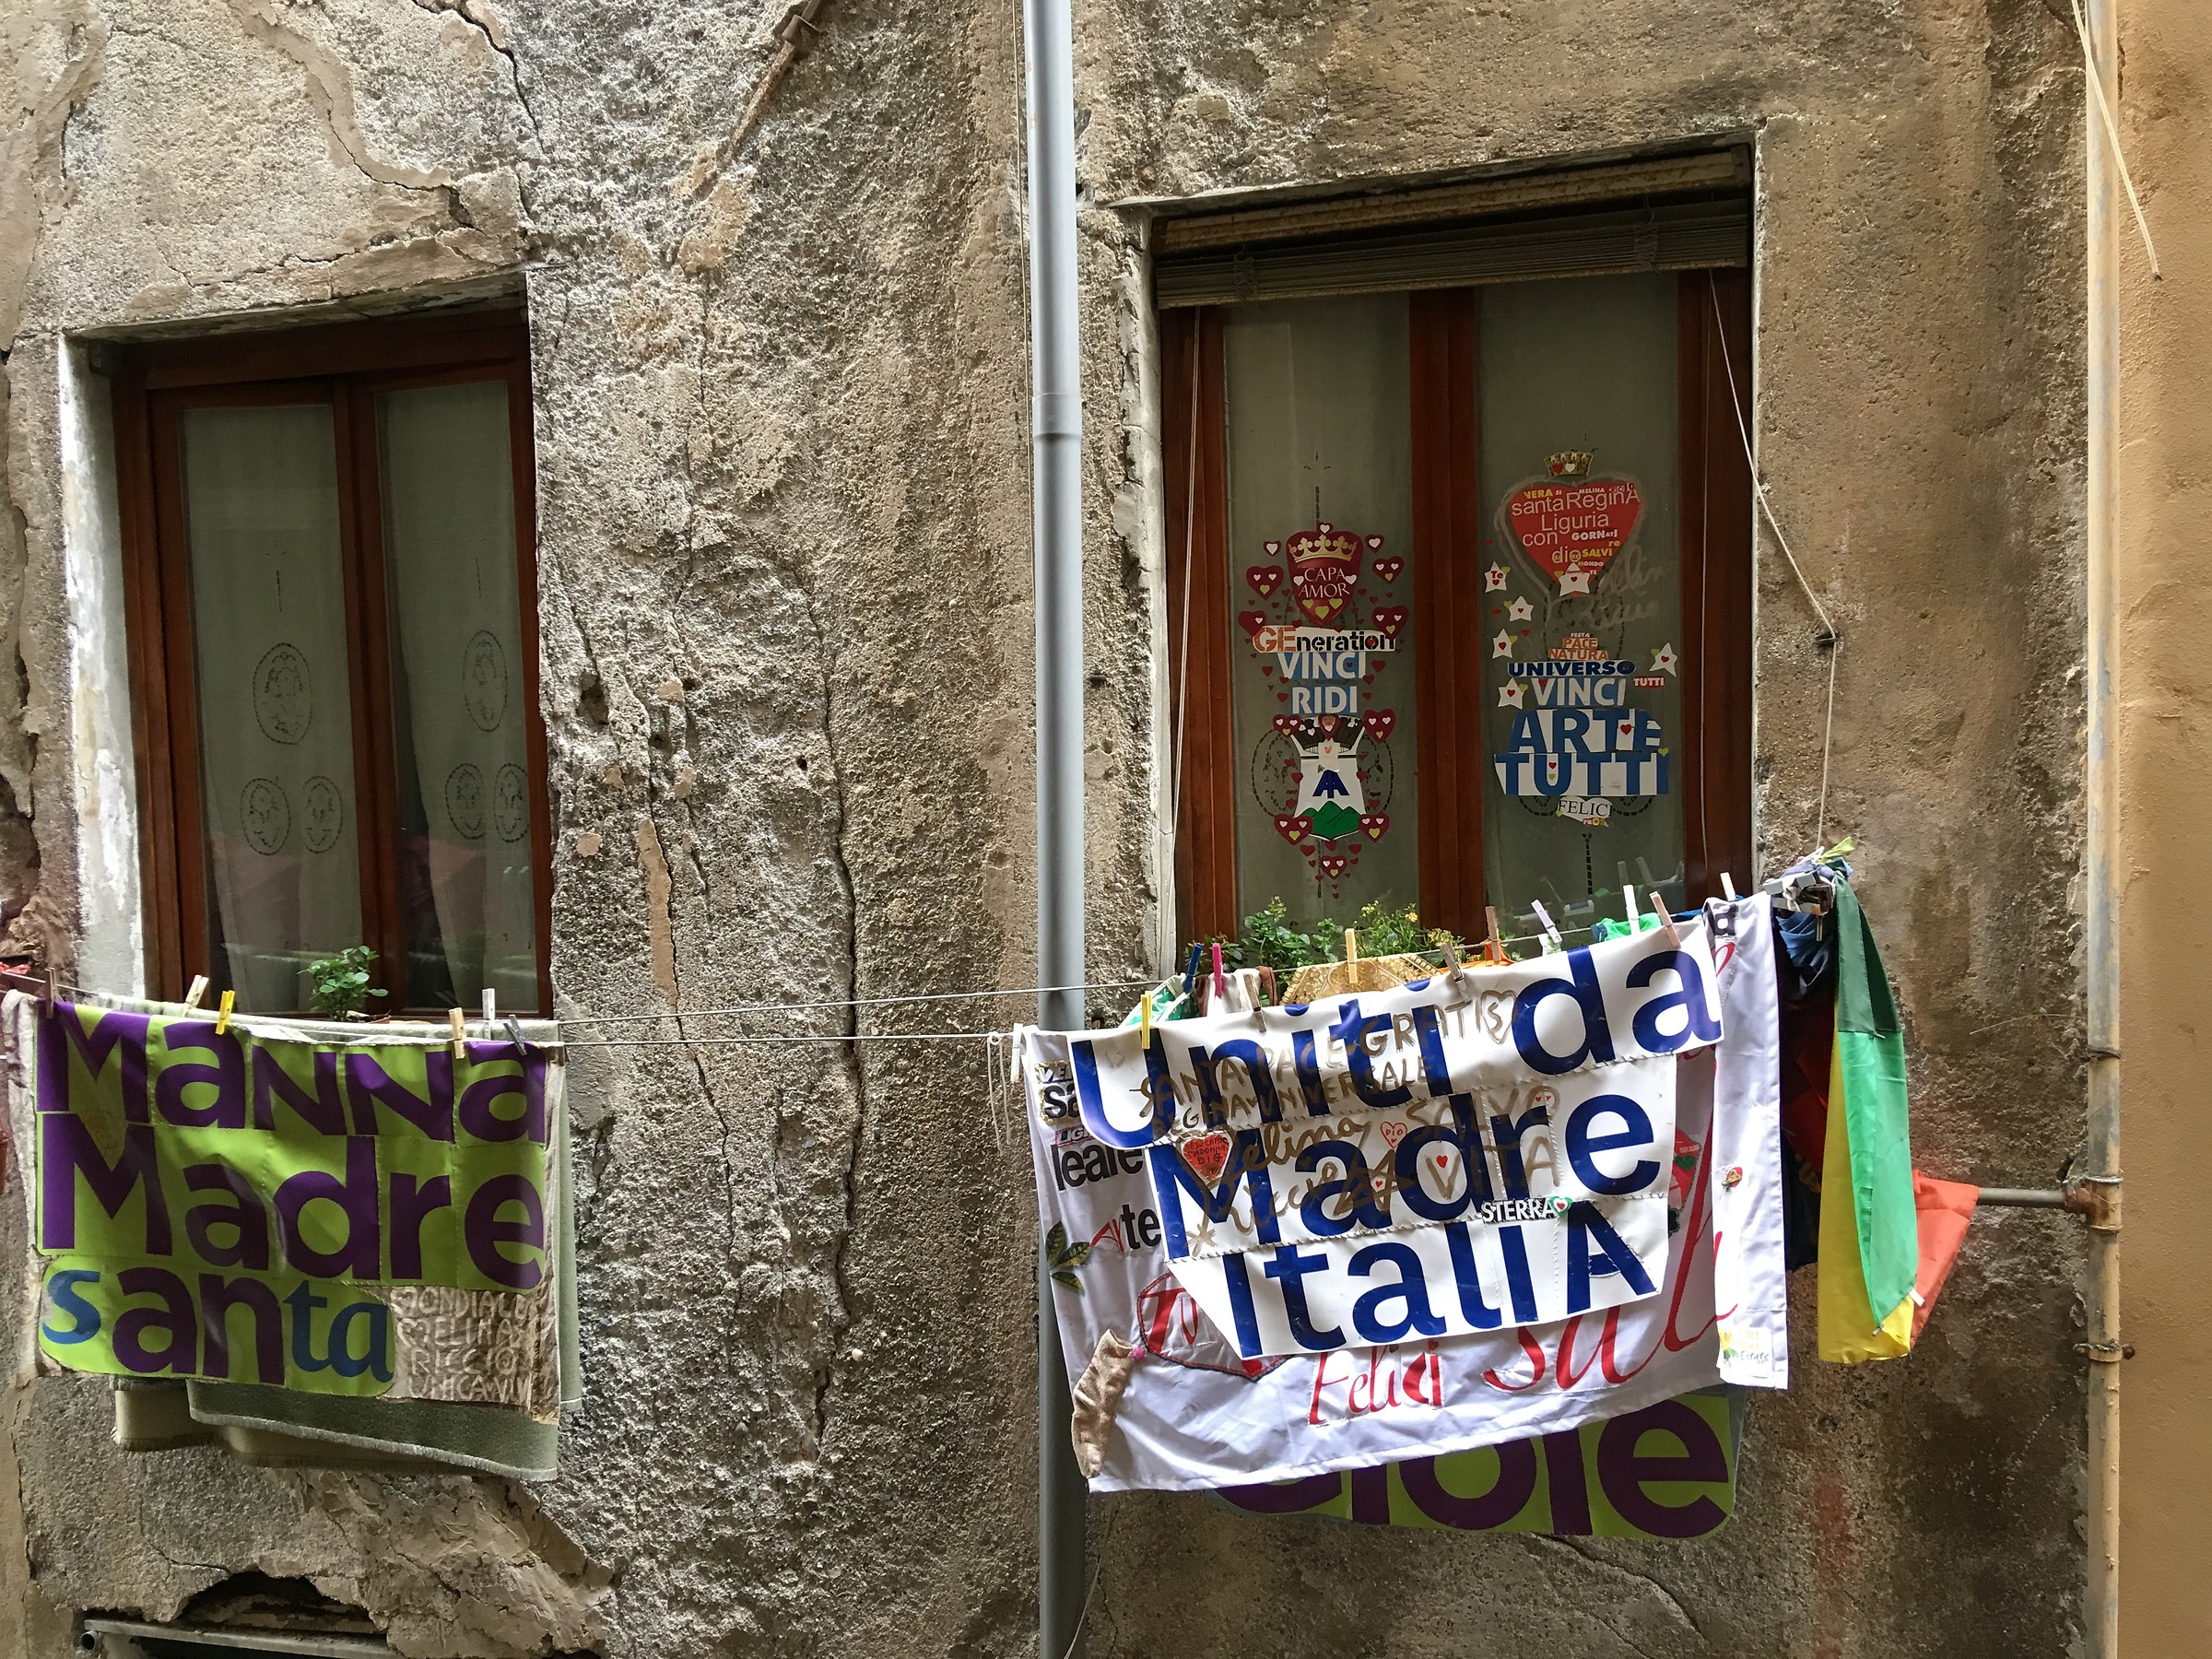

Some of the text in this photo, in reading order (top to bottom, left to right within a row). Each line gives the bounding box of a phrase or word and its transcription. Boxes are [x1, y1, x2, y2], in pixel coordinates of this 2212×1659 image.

[1524, 488, 1553, 499] VERA
[1541, 512, 1609, 534] Liguria
[1523, 532, 1558, 547] con
[1582, 548, 1613, 558] SALVI
[1304, 567, 1346, 582] CAPA
[1298, 583, 1349, 598] AMOR
[1253, 627, 1394, 652] GEneration
[1562, 638, 1598, 649] PACE
[1277, 651, 1366, 678] VINCI
[1548, 649, 1609, 660] NATURA
[1508, 661, 1636, 677] UNIVERSO
[1531, 677, 1626, 707] VINCI
[1633, 677, 1665, 687] TUTTI
[1292, 686, 1358, 713] RIDI
[1508, 709, 1662, 754] ARTE
[1495, 753, 1670, 795] TUTTI
[1071, 945, 1725, 1149] Uniti da
[1148, 1093, 1663, 1260] Madre
[41, 1113, 545, 1289] Madre
[41, 1266, 396, 1385] santa
